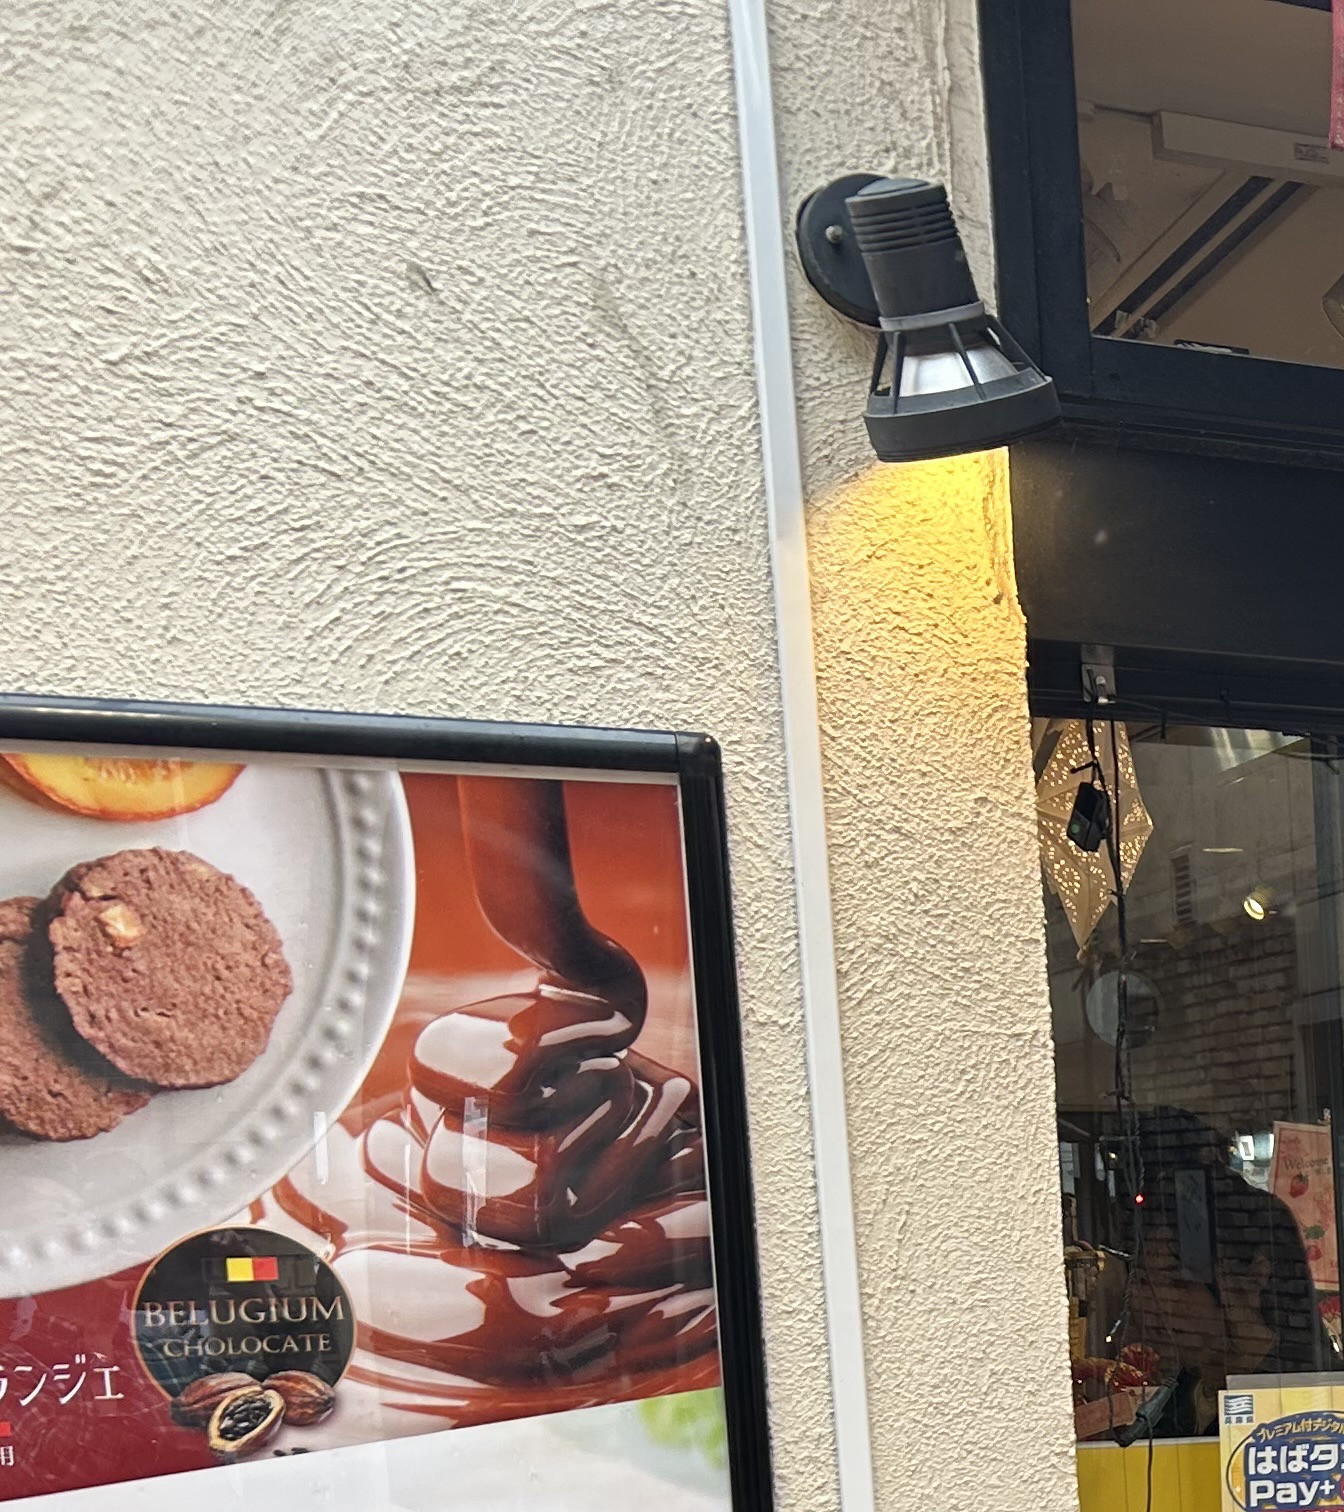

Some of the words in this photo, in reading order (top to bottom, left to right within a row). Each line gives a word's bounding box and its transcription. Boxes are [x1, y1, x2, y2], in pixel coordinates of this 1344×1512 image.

[144, 1296, 345, 1328] BELUGIUM
[162, 1331, 332, 1358] CHOLOCATE
[0, 1353, 124, 1406] ンジエ
[1250, 1478, 1335, 1507] Pay+
